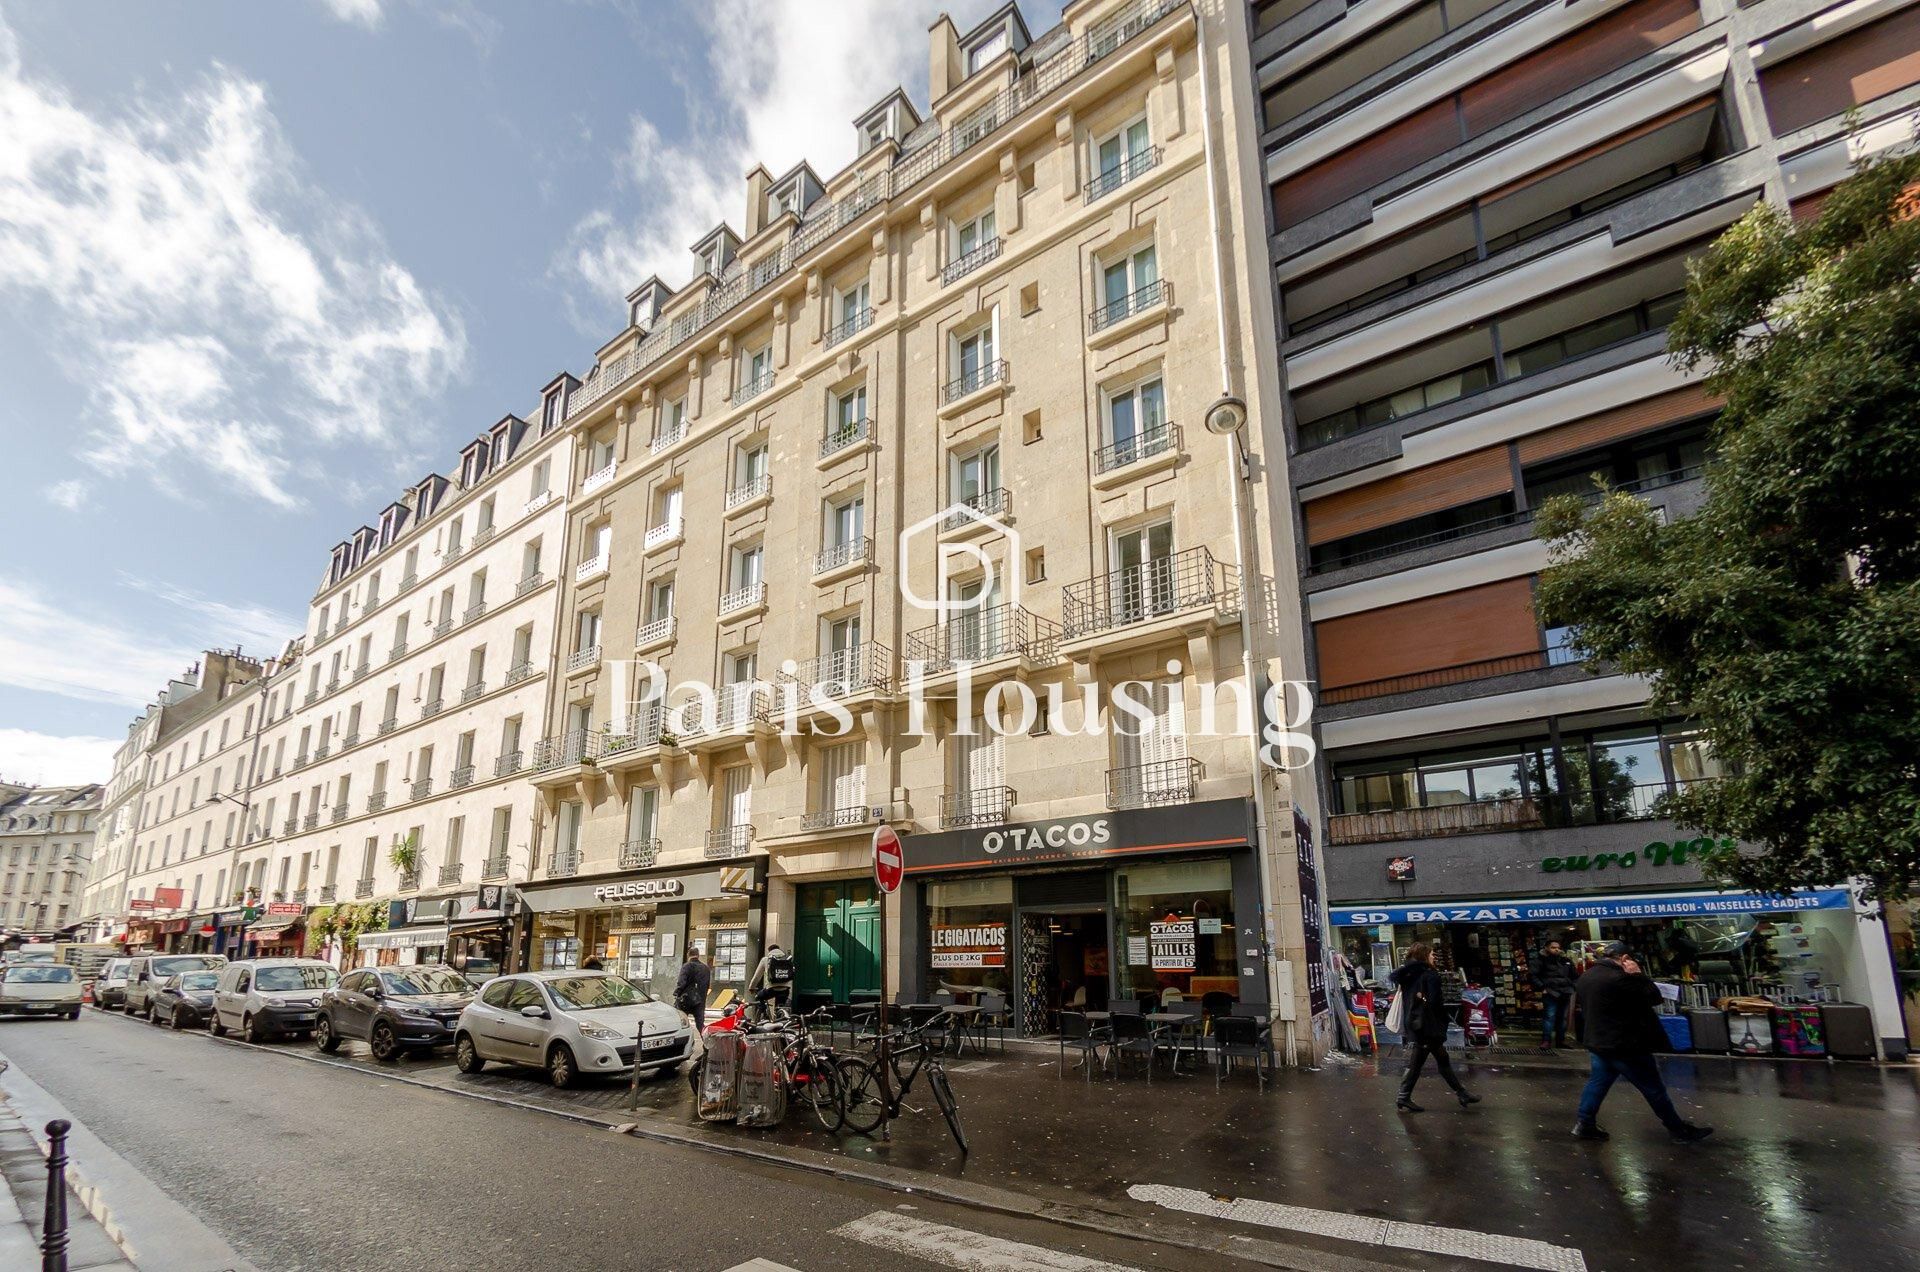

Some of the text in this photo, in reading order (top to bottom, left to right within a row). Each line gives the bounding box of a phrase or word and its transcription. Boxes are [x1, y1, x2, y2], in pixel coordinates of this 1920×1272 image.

[982, 819, 1111, 853] O'TACOS
[1541, 851, 1636, 873] euro
[593, 879, 679, 899] PELISSOLO
[1351, 912, 1389, 923] SD
[1406, 908, 1522, 922] BAZAR
[1527, 908, 1568, 918] CADEAUX
[1574, 906, 1608, 917] JOUETS
[1615, 904, 1643, 915] LINGE
[1644, 904, 1657, 914] DE
[1658, 903, 1697, 913] MAISON
[1703, 900, 1763, 911] VAISSELLES
[1771, 897, 1819, 909] GADJETS
[1150, 924, 1194, 933] O'TACOS
[1151, 943, 1195, 955] TAILLES
